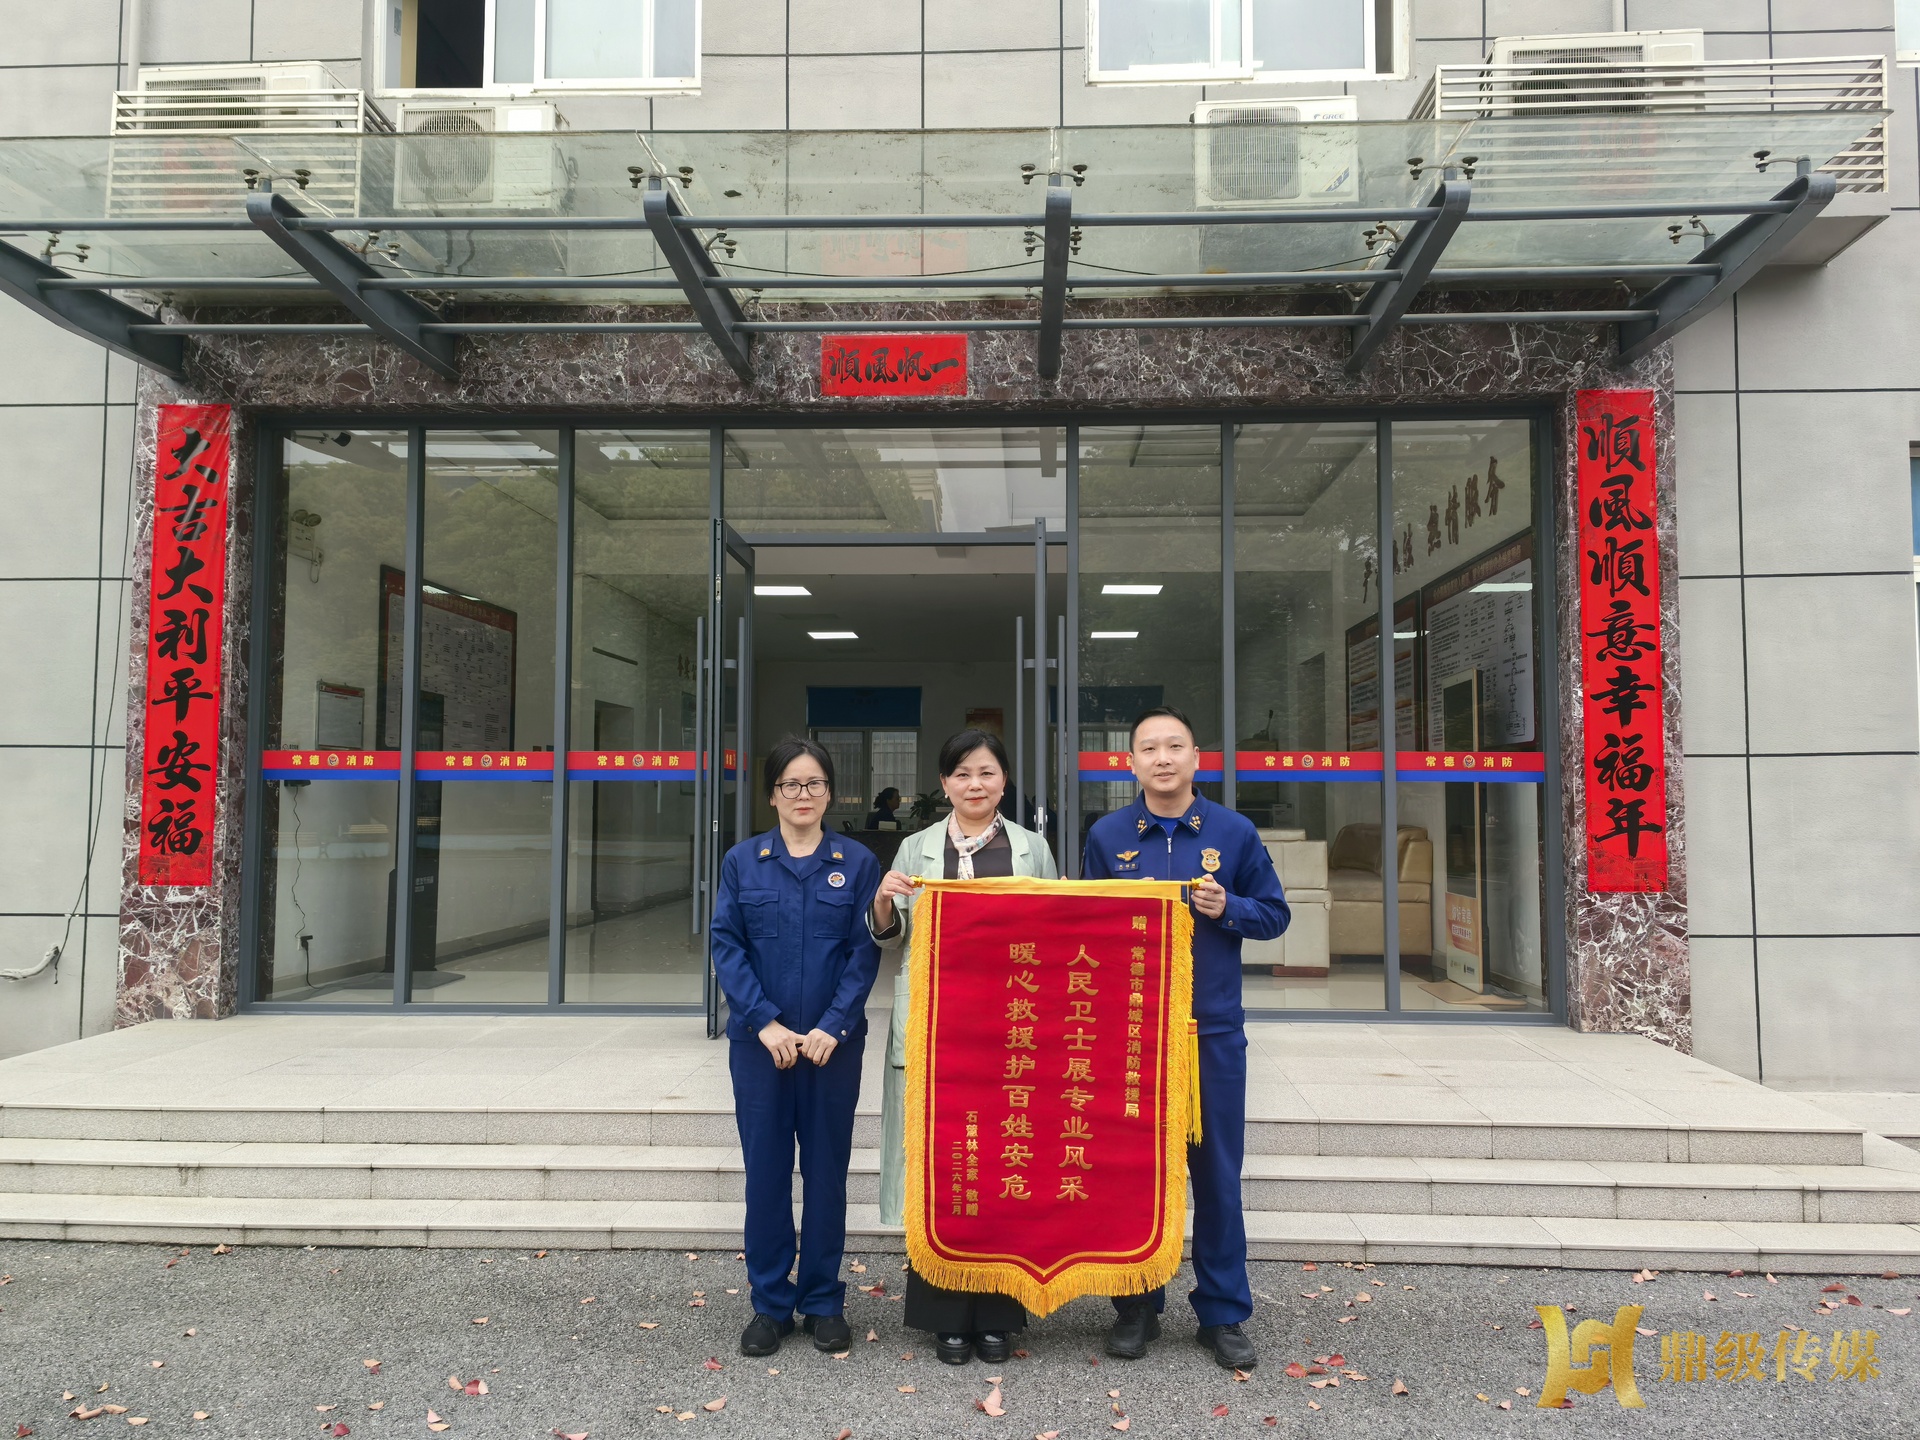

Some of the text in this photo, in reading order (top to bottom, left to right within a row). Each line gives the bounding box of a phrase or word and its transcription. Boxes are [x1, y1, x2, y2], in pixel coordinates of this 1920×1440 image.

[147, 426, 219, 856] 大吉大利平安福
[999, 942, 1042, 1201] 暖心救援护百姓安危
[1056, 944, 1100, 1202] 人民卫士展专业风采
